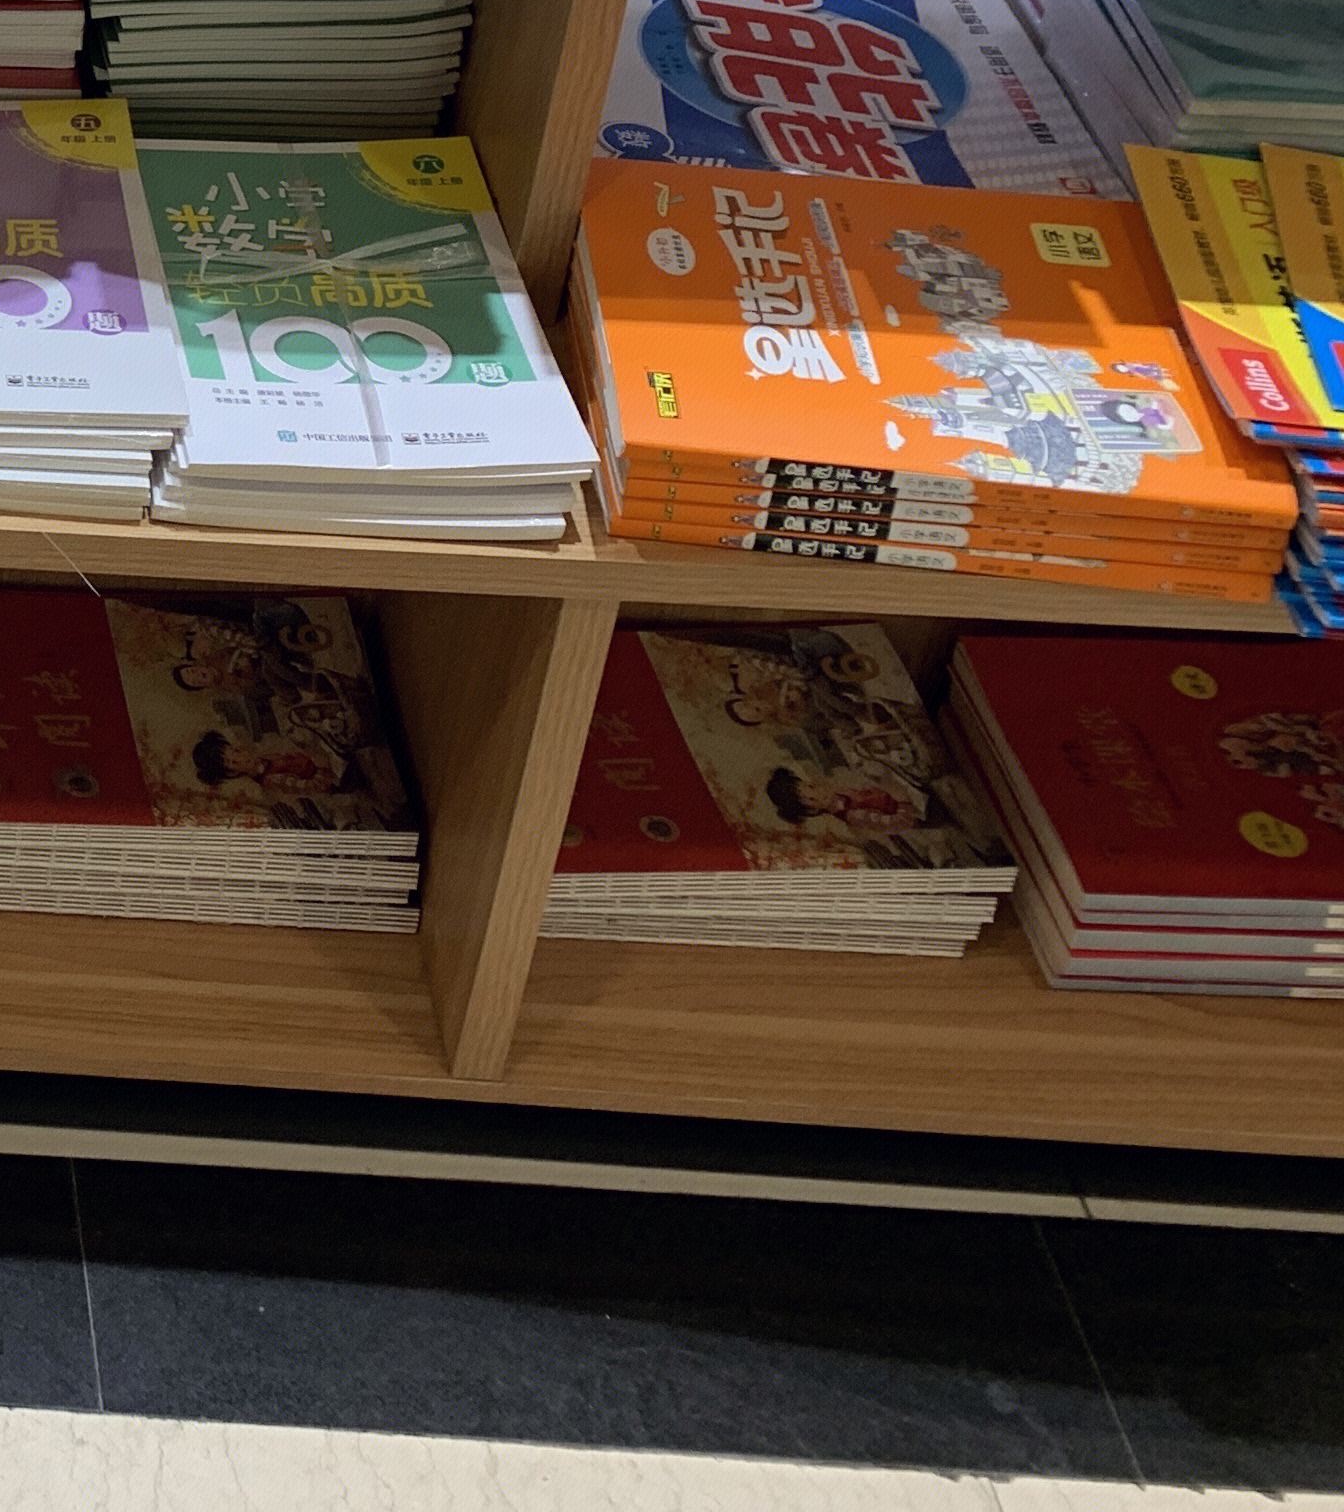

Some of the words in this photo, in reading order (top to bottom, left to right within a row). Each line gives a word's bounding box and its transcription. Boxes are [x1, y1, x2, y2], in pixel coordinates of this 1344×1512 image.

[205, 170, 325, 212] 小学
[166, 203, 334, 258] 数学
[187, 268, 435, 310] 轻负高质
[712, 185, 848, 384] 星选手记
[84, 310, 125, 335] 题
[196, 310, 453, 386] 100
[469, 361, 512, 386] 题
[1256, 357, 1290, 414] Collins
